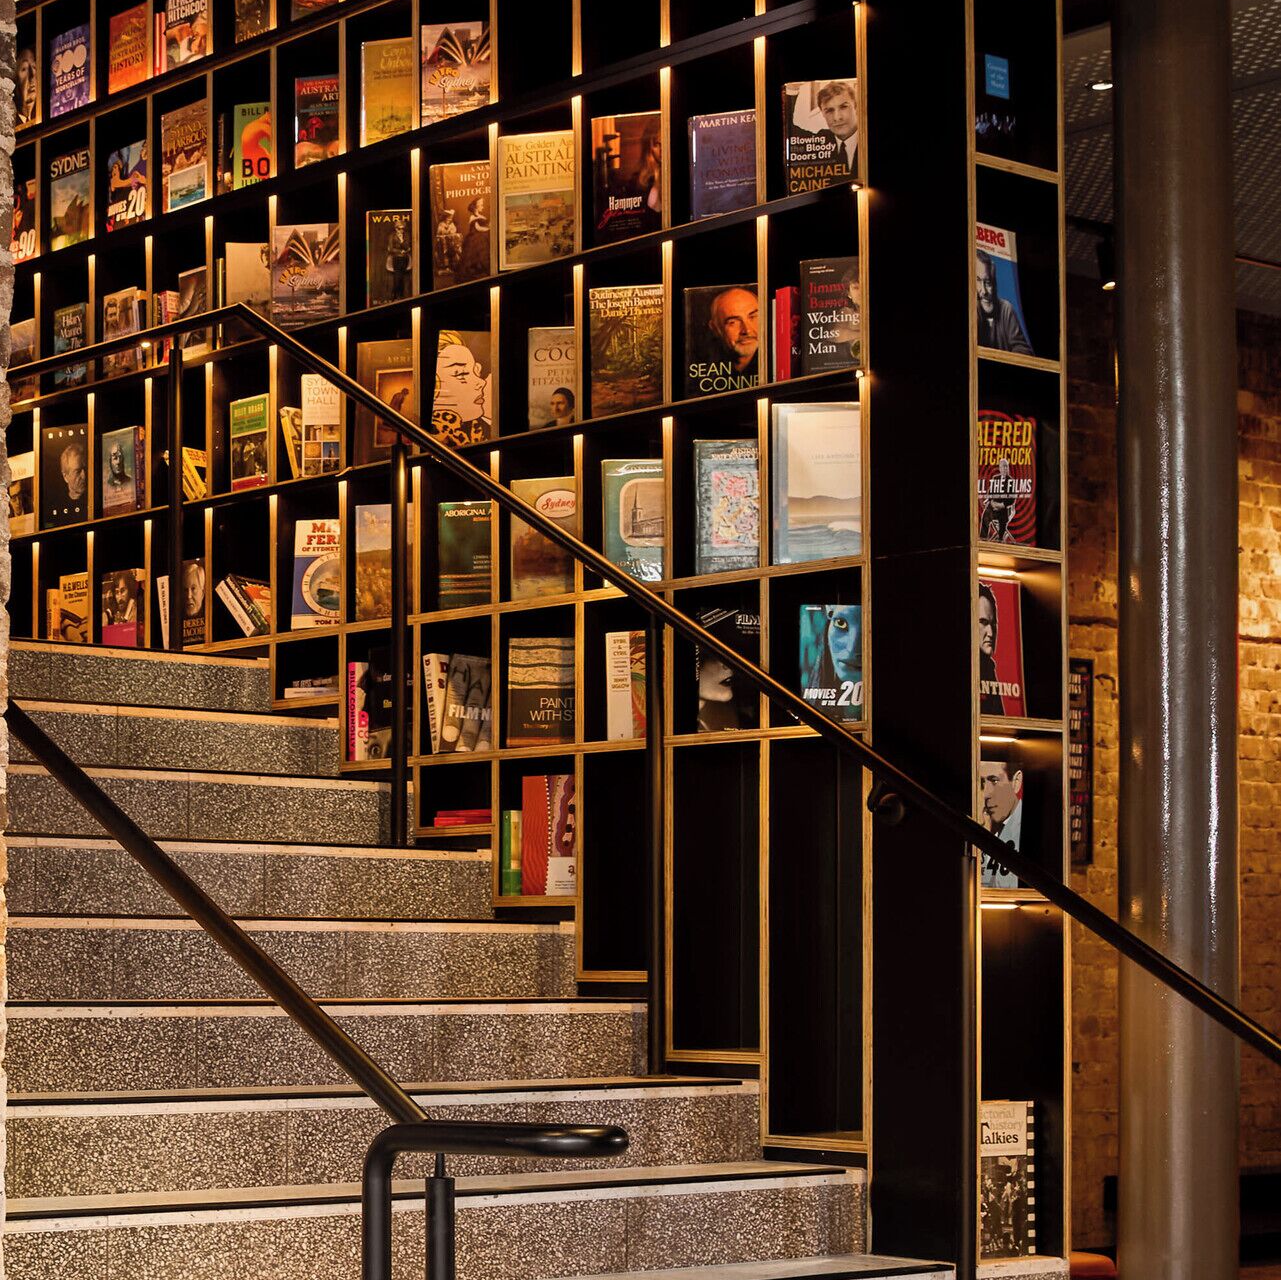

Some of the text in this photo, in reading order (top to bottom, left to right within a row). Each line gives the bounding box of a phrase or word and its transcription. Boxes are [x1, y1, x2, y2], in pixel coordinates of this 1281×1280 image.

[110, 53, 145, 74] HISTORY
[56, 67, 86, 85] YEARS OF
[241, 106, 259, 117] BILL
[699, 116, 737, 129] MARTIN
[506, 142, 522, 153] The
[525, 140, 555, 151] Golden
[790, 135, 826, 146] Blowing
[806, 141, 836, 152] Bloody
[506, 147, 574, 166] AUSTRAL
[790, 150, 832, 162] Doors Off
[459, 171, 490, 183] HISTO
[790, 163, 851, 179] MICHAEL
[789, 178, 831, 193] CAINE
[608, 195, 643, 211] Hammer
[371, 213, 411, 224] WARH
[976, 225, 1006, 248] BERG
[19, 228, 36, 260] 90
[808, 280, 846, 295] Jimmy
[590, 296, 661, 310] The Joseph Brown
[600, 305, 663, 318] Daniel Thomas
[807, 311, 860, 325] Working
[808, 326, 840, 340] Class
[808, 342, 837, 355] Man
[688, 360, 732, 379] SEAN
[306, 387, 339, 396] TOWN
[307, 396, 336, 406] HALL
[977, 421, 1032, 447] ALFRED
[978, 447, 1032, 466] ITCHCOCK
[977, 478, 1032, 495] LL THE FILMS
[541, 497, 576, 511] Sydney
[444, 508, 486, 518] ABORIGINAL
[306, 533, 340, 546] FER
[803, 688, 837, 700] MOVIES
[979, 680, 1021, 698] NTINO
[539, 697, 575, 709] PAINT
[448, 703, 478, 720] FILM
[529, 709, 562, 722] WITH
[980, 1122, 1019, 1145] Talkies
